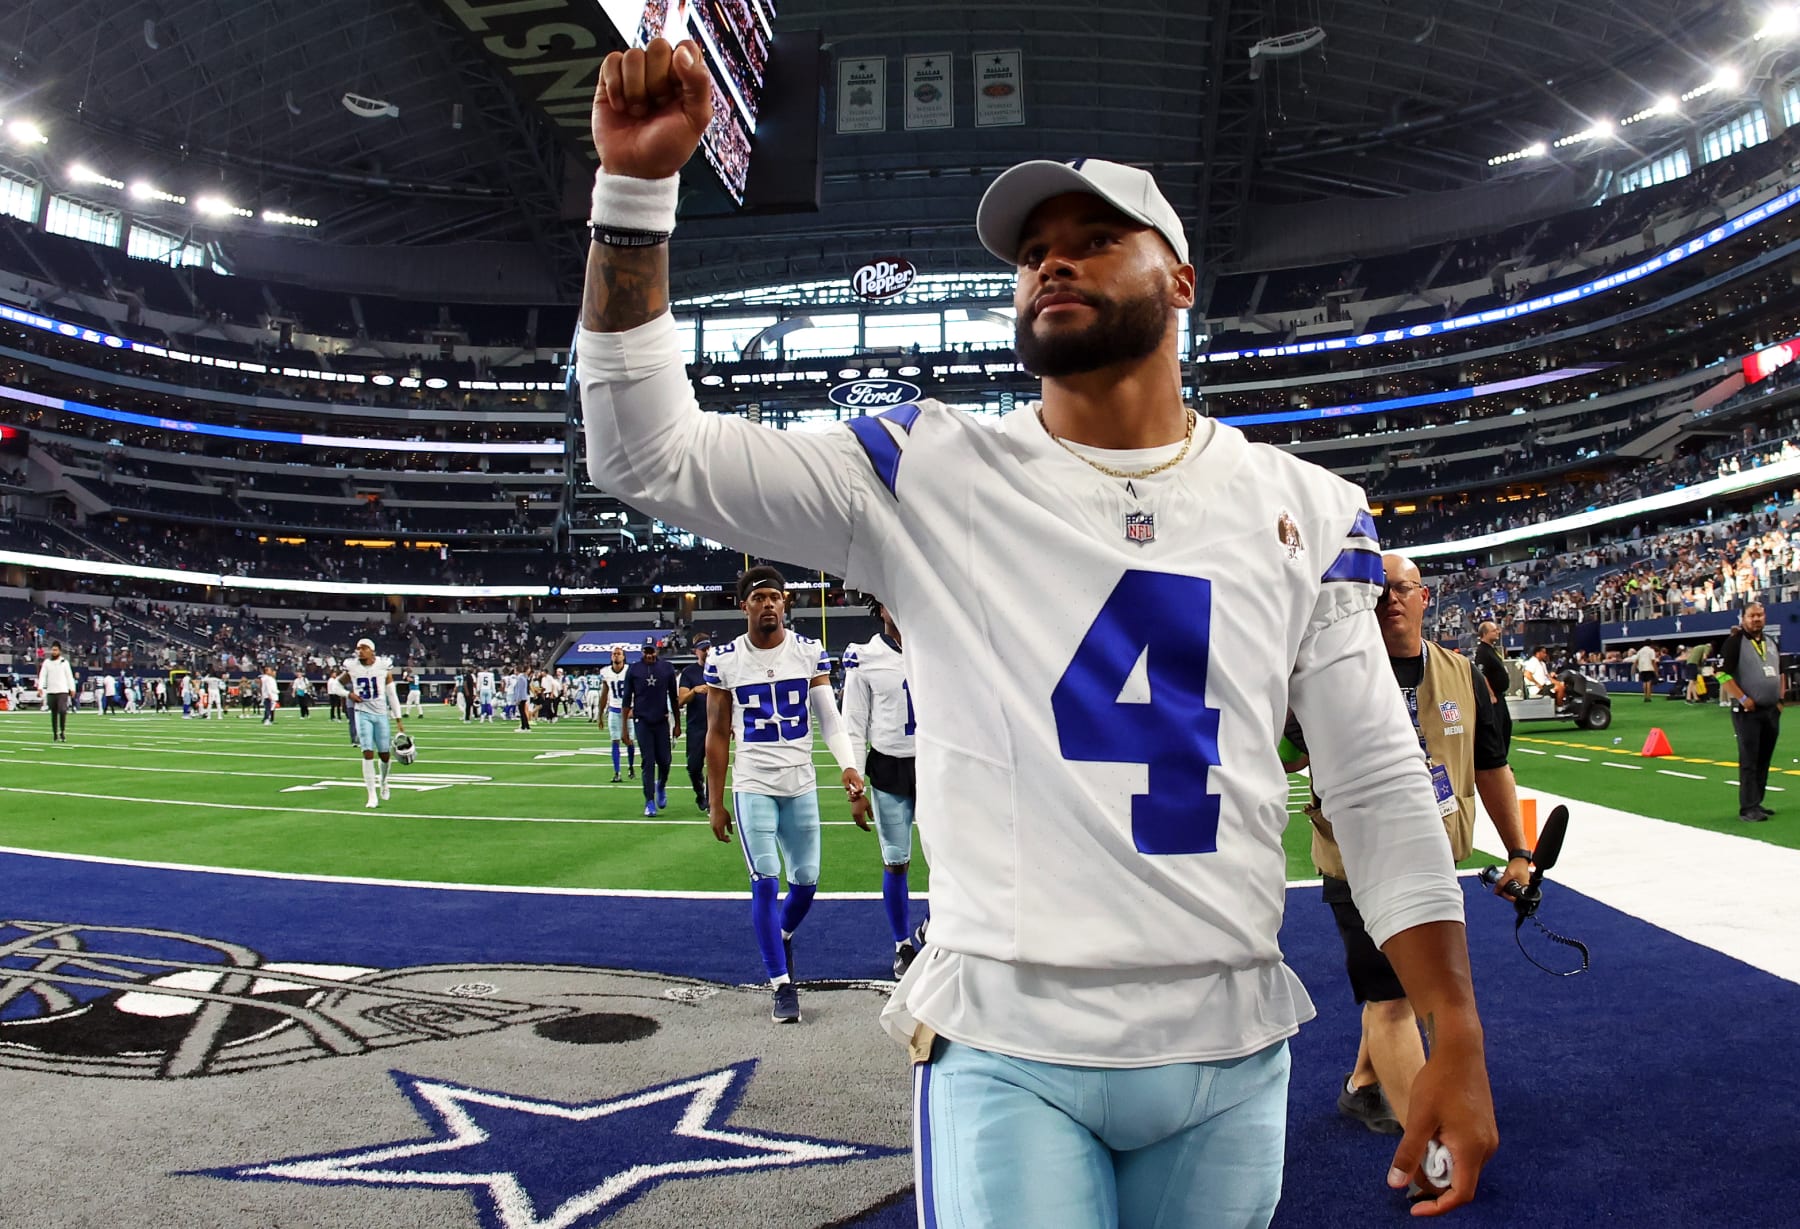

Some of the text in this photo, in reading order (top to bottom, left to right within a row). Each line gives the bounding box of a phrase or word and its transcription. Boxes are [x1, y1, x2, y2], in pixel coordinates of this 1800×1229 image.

[875, 261, 899, 280] Dr
[853, 265, 912, 296] Pepper
[846, 382, 902, 404] Ford
[1127, 524, 1153, 538] NFL
[560, 586, 619, 595] Blockchain.com
[662, 584, 723, 593] Blockchain.com
[577, 642, 642, 653] Tostito
[356, 675, 380, 699] 31
[482, 676, 489, 687] 5
[735, 677, 811, 743] 29
[1050, 568, 1222, 856] 4
[1443, 709, 1460, 721] NFL
